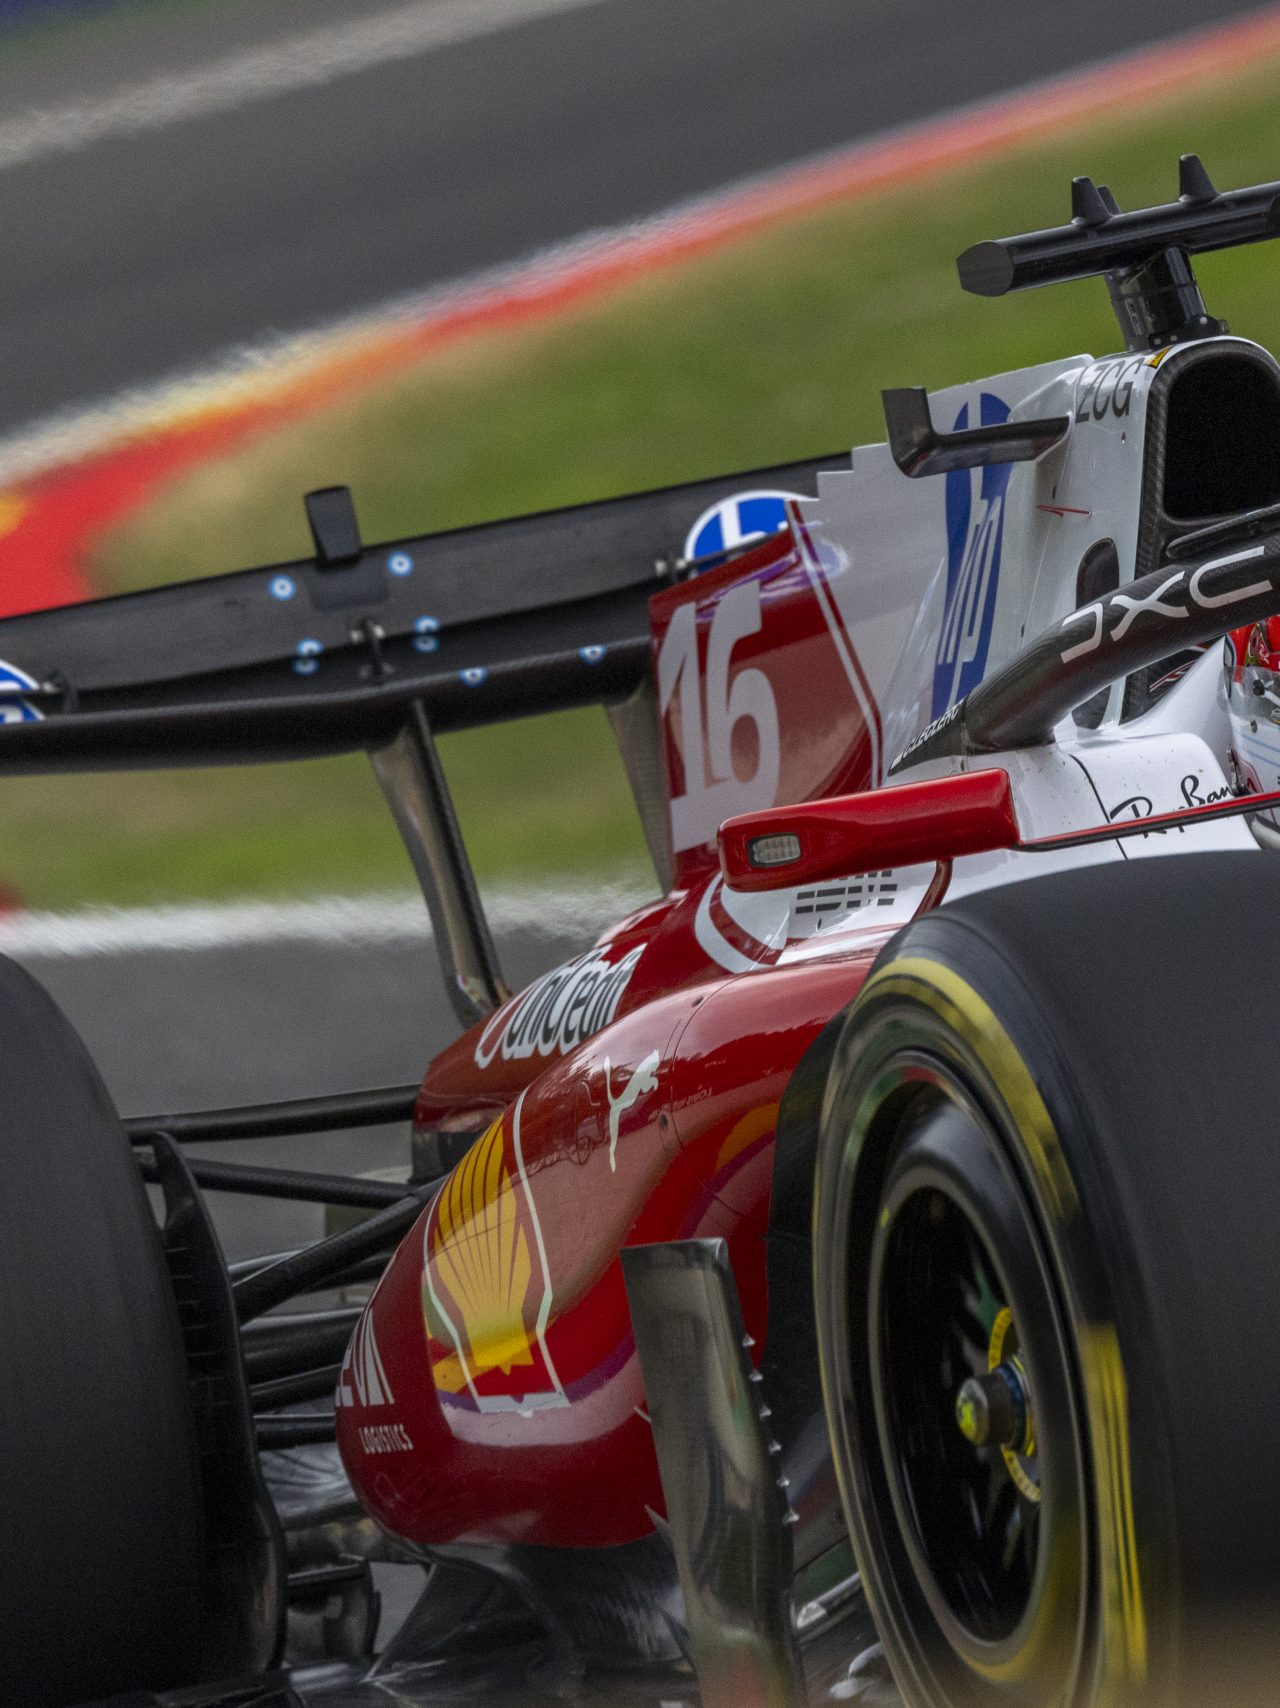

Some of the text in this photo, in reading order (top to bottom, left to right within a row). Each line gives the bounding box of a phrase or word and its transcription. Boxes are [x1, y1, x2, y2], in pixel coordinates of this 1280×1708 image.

[1060, 546, 1273, 664] DXC
[658, 580, 781, 854] 16
[359, 1423, 414, 1455] LOGISTICS
